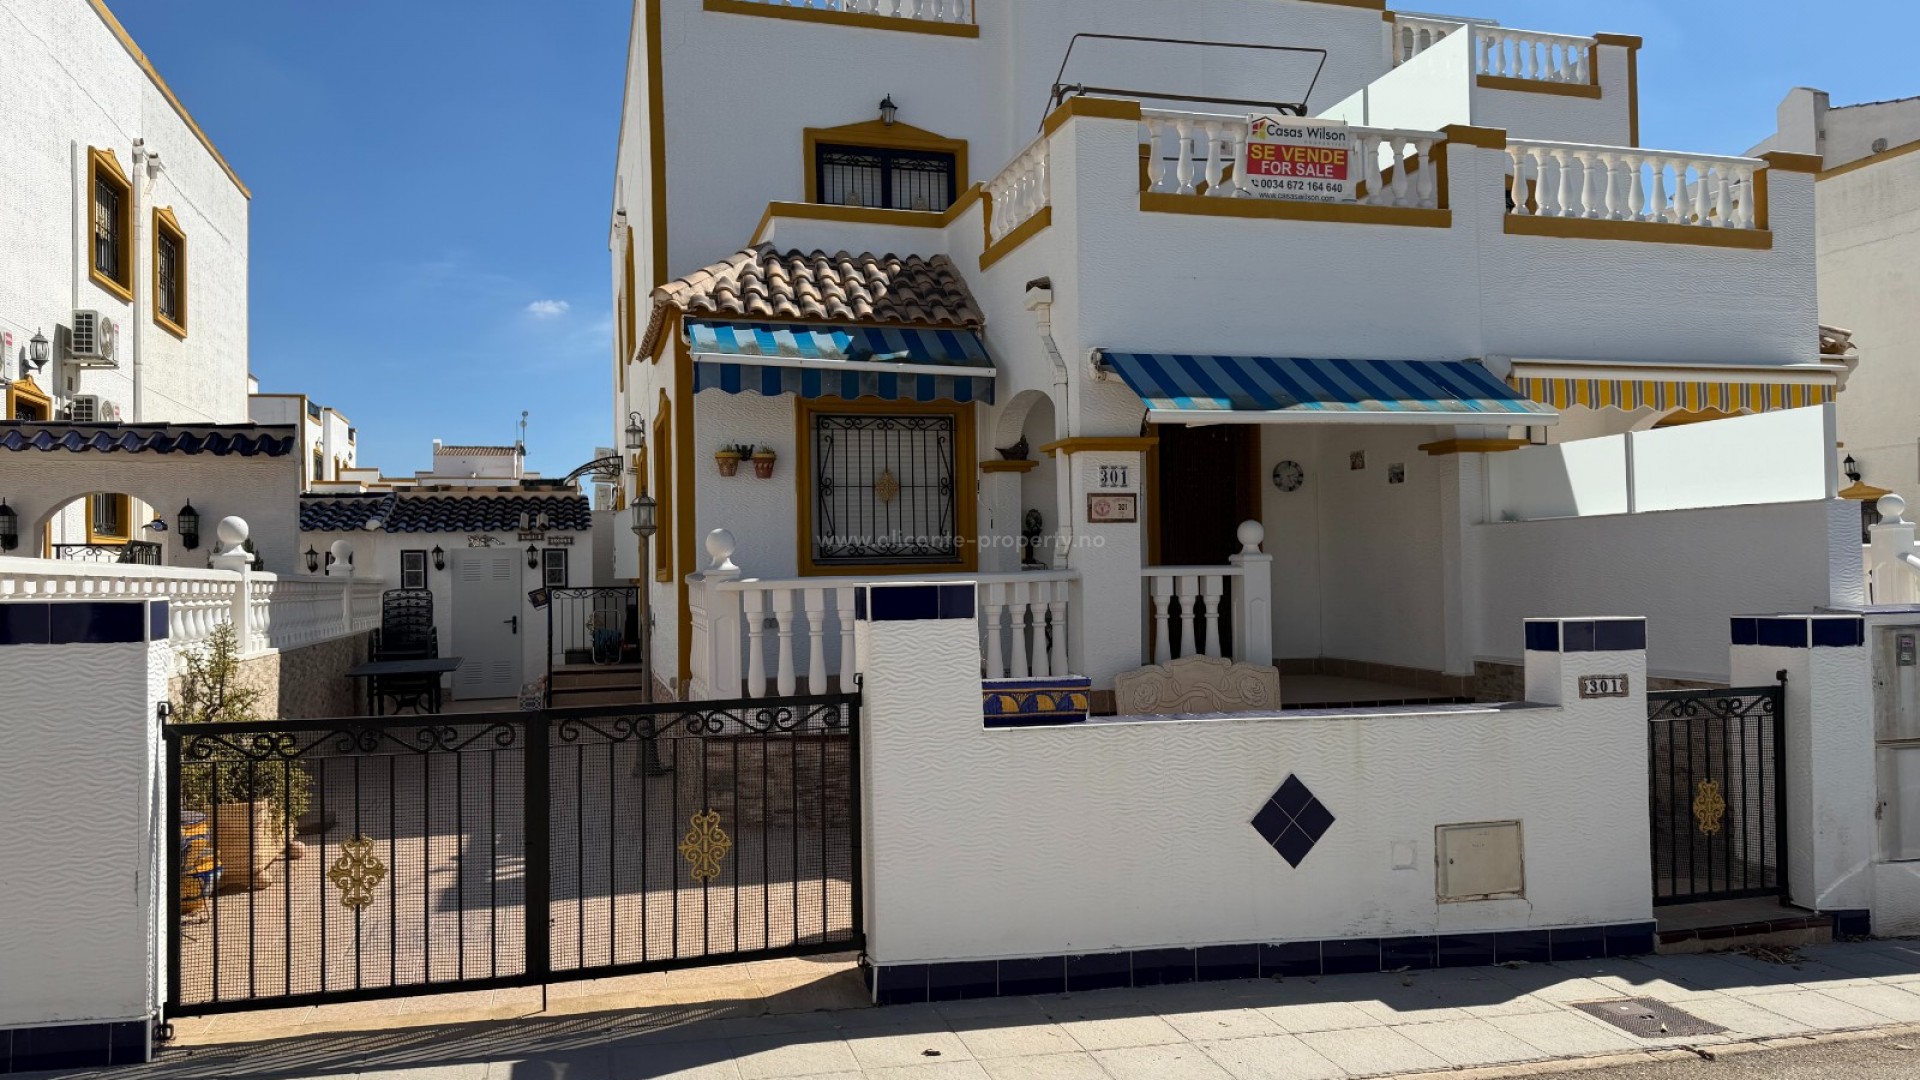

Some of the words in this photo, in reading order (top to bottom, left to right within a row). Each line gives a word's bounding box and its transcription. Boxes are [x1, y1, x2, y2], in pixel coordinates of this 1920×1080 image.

[1266, 124, 1303, 138] Casas
[1306, 126, 1346, 141] Wilson
[1250, 144, 1276, 160] SE
[1281, 146, 1345, 165] VENDE
[1261, 161, 1291, 175] FOR
[1296, 163, 1334, 177] SALE
[1260, 180, 1284, 189] 0034
[1287, 181, 1304, 190] 672
[1307, 181, 1323, 192] 164
[1326, 183, 1343, 193] 640
[1100, 469, 1127, 486] 301
[1589, 680, 1617, 693] 301
